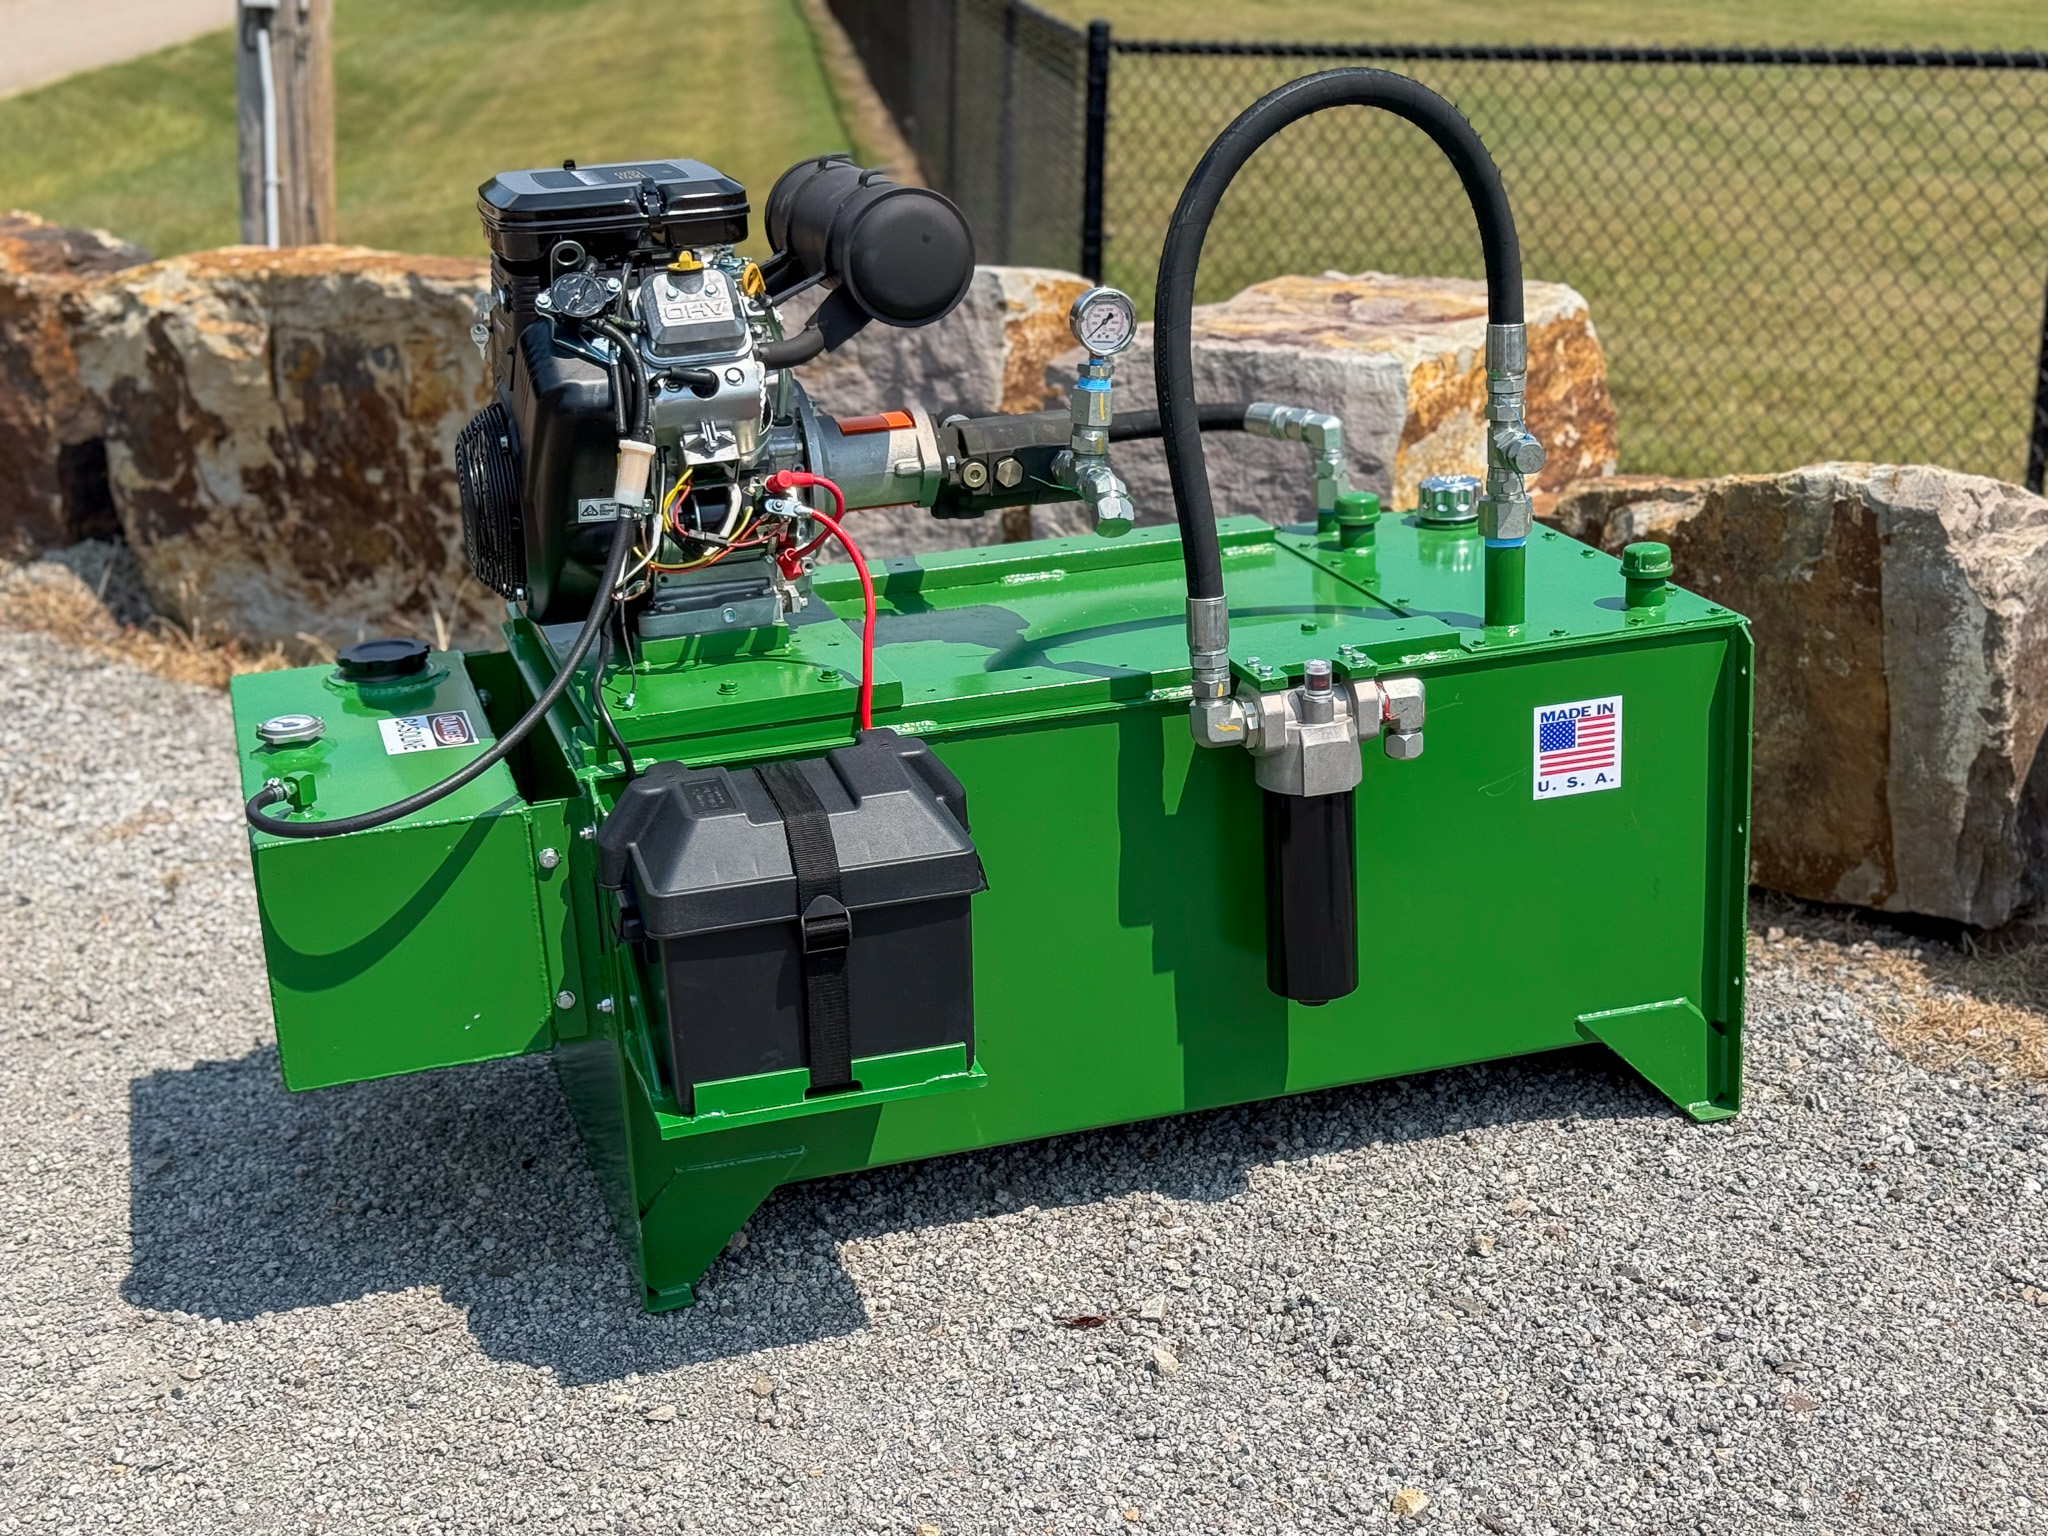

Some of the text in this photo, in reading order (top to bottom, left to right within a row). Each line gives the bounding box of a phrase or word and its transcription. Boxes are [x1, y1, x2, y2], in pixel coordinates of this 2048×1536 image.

[1540, 703, 1614, 723] MADE IN
[438, 715, 465, 743] DANGER
